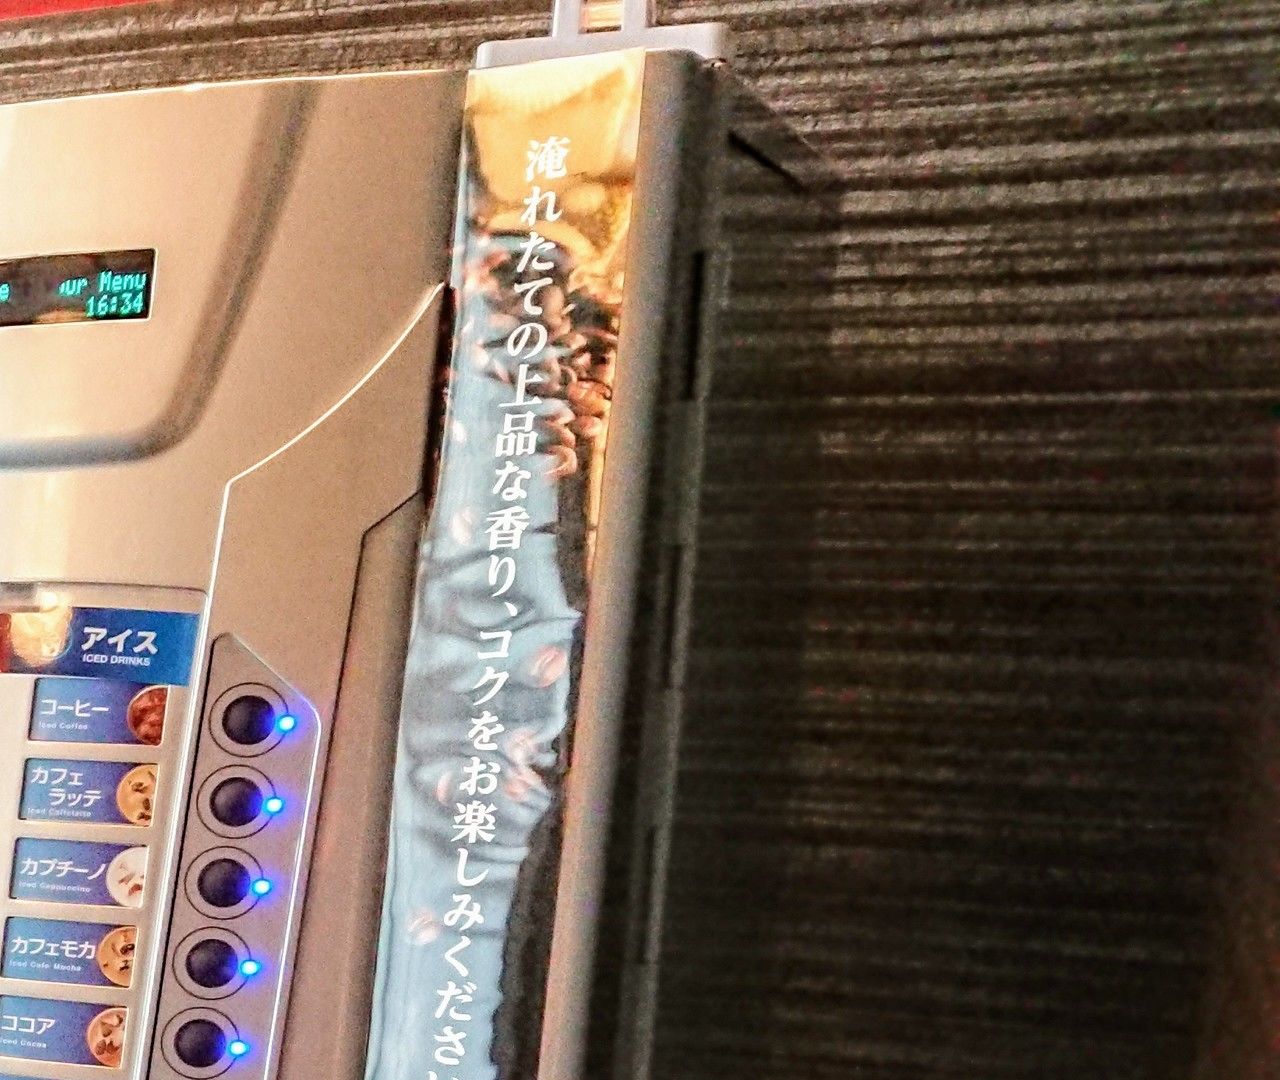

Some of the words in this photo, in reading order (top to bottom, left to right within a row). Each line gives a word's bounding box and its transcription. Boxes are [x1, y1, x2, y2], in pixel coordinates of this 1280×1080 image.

[98, 269, 148, 292] Menu
[86, 291, 144, 318] 16:34
[80, 626, 159, 654] アイス
[82, 653, 108, 664] ICED
[110, 655, 151, 667] DRINKS
[40, 699, 110, 718] コーヒー
[31, 766, 84, 786] カフェ
[48, 787, 102, 807] ラッテ
[10, 937, 96, 959] カフェモカ
[1, 1014, 56, 1035] ココア
